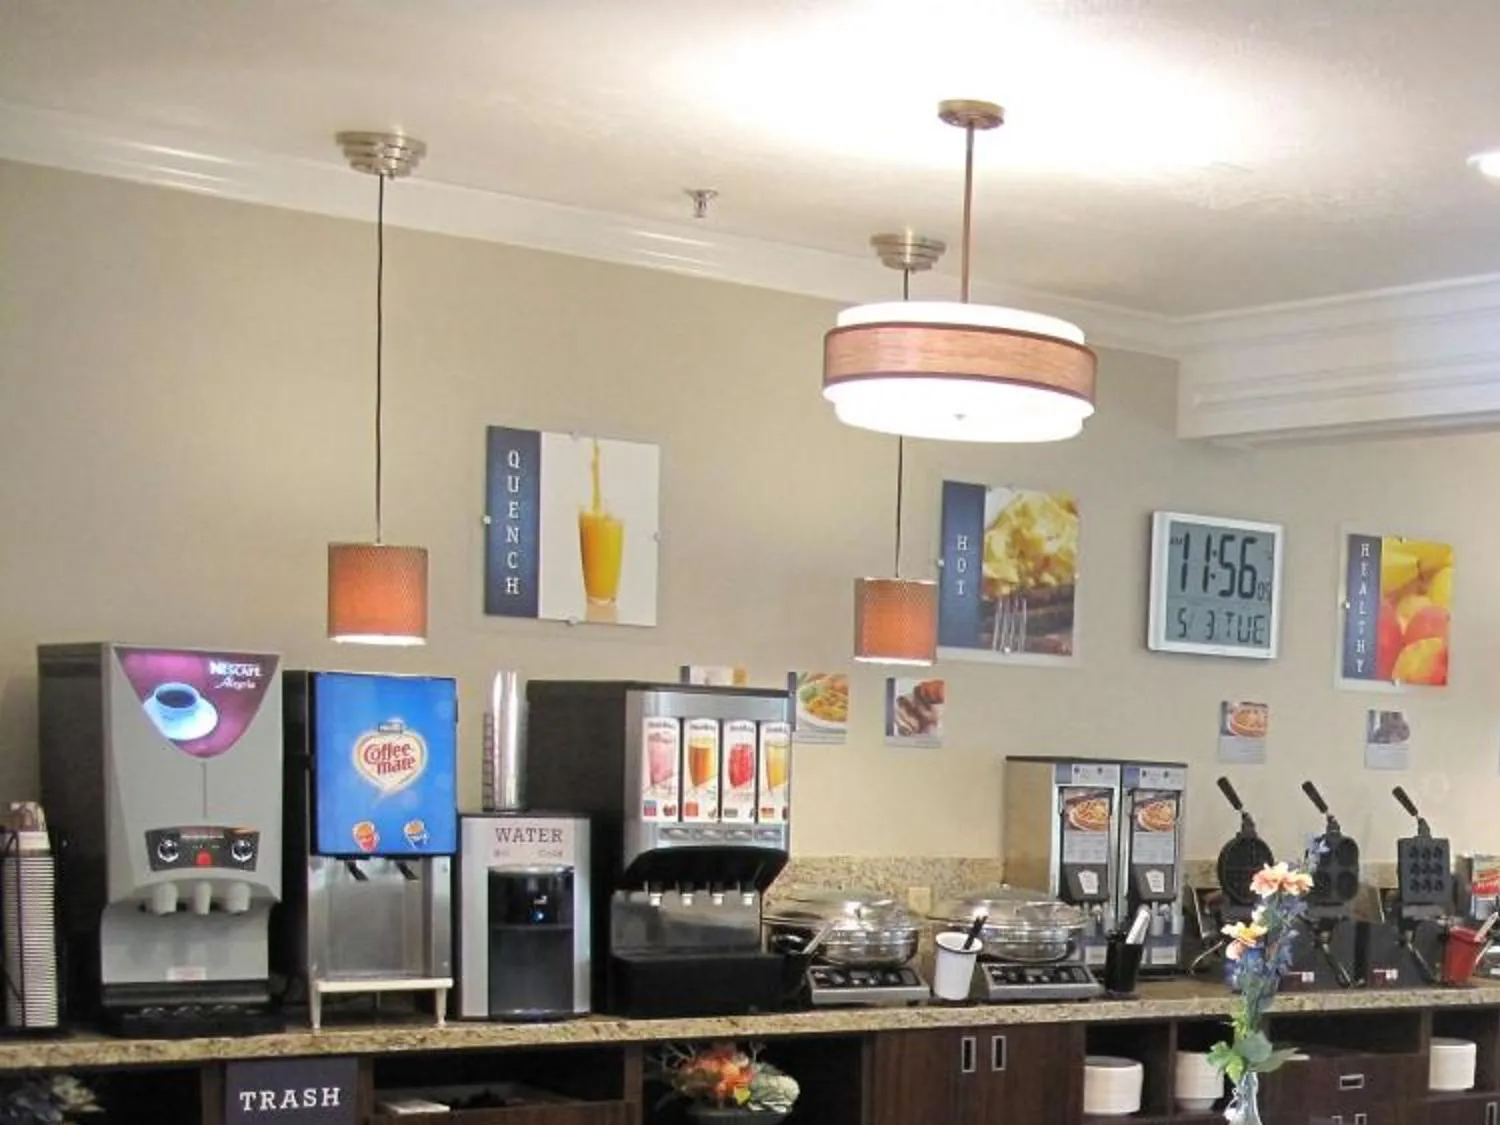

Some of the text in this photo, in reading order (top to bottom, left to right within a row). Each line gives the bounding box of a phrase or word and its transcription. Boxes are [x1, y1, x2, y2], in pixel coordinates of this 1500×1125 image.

[506, 449, 520, 595] QUENCH
[1180, 532, 1258, 599] 11:56
[1356, 543, 1370, 673] HEALTHY
[1224, 611, 1265, 644] TUE
[364, 742, 412, 765] Coffee
[377, 756, 416, 776] mate
[495, 826, 563, 843] WATER
[239, 1087, 341, 1112] TRASH
